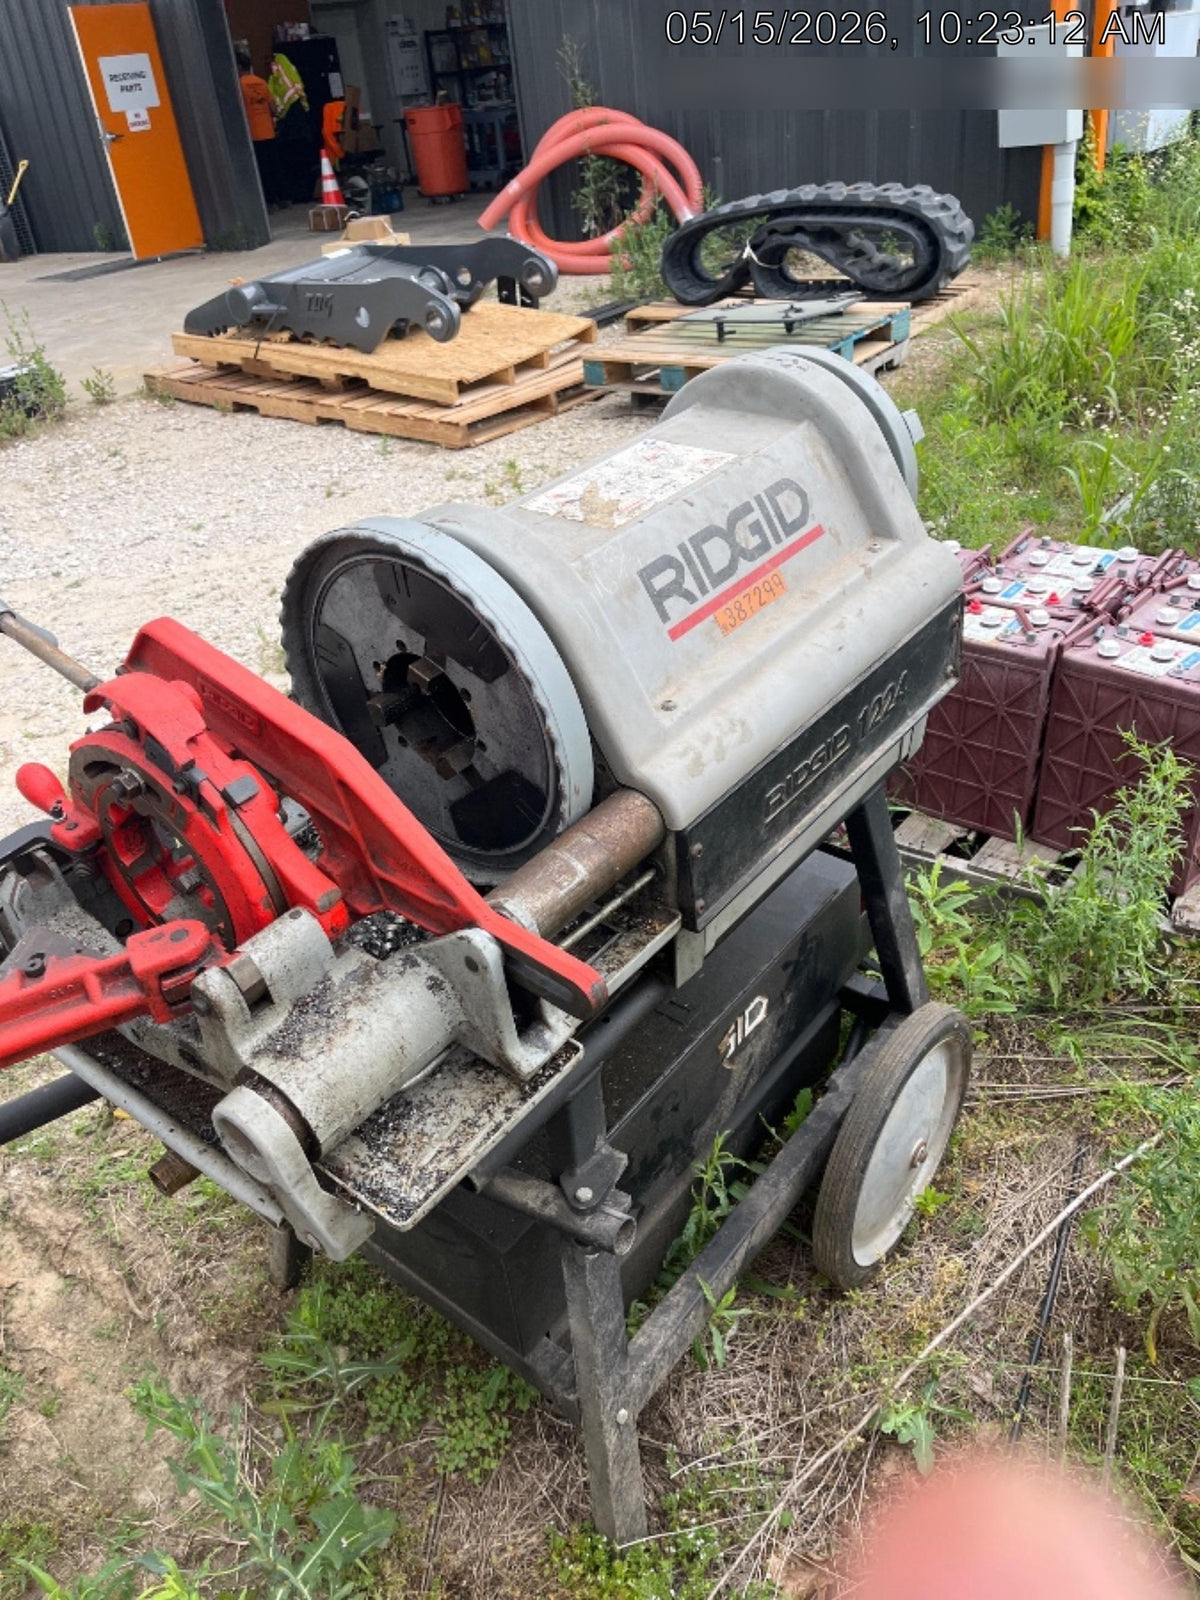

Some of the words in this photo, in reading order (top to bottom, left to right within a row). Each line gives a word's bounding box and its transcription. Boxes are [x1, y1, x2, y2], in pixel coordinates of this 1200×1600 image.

[109, 71, 147, 82] RECEIVING
[121, 83, 143, 92] PARTS
[636, 477, 810, 625] RIDGID
[724, 573, 785, 629] 387299
[764, 723, 851, 820] RIDGID
